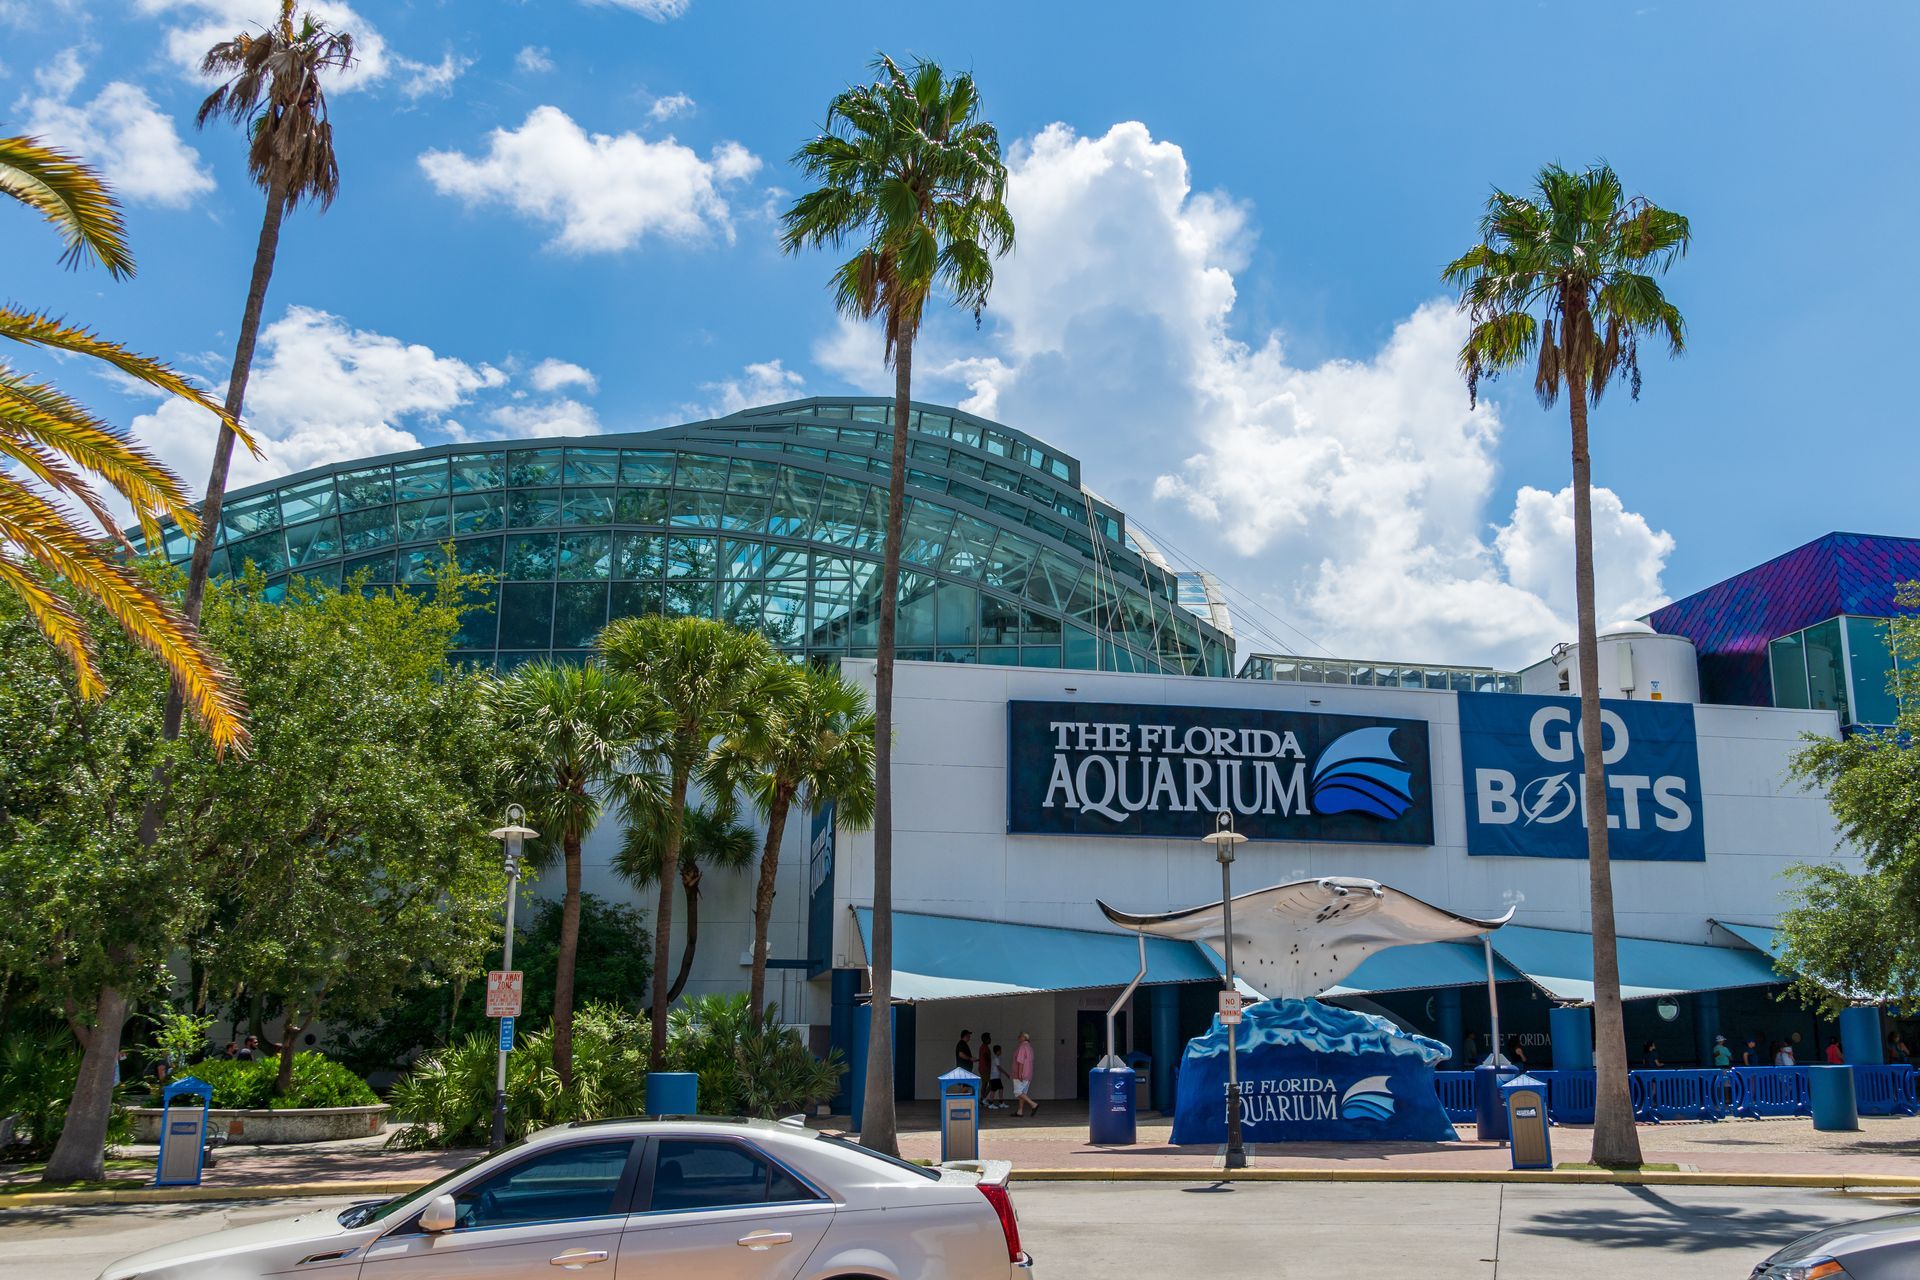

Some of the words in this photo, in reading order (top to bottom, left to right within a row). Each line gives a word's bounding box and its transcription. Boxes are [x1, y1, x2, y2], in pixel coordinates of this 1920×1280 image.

[1050, 721, 1131, 752] THE
[1138, 724, 1305, 760] FLORIDA
[1529, 706, 1630, 765] GO
[1042, 753, 1311, 822] AQUARIUM
[497, 982, 513, 990] ZONE
[1483, 1033, 1505, 1047] TE
[1260, 1078, 1338, 1094] FLORIDA
